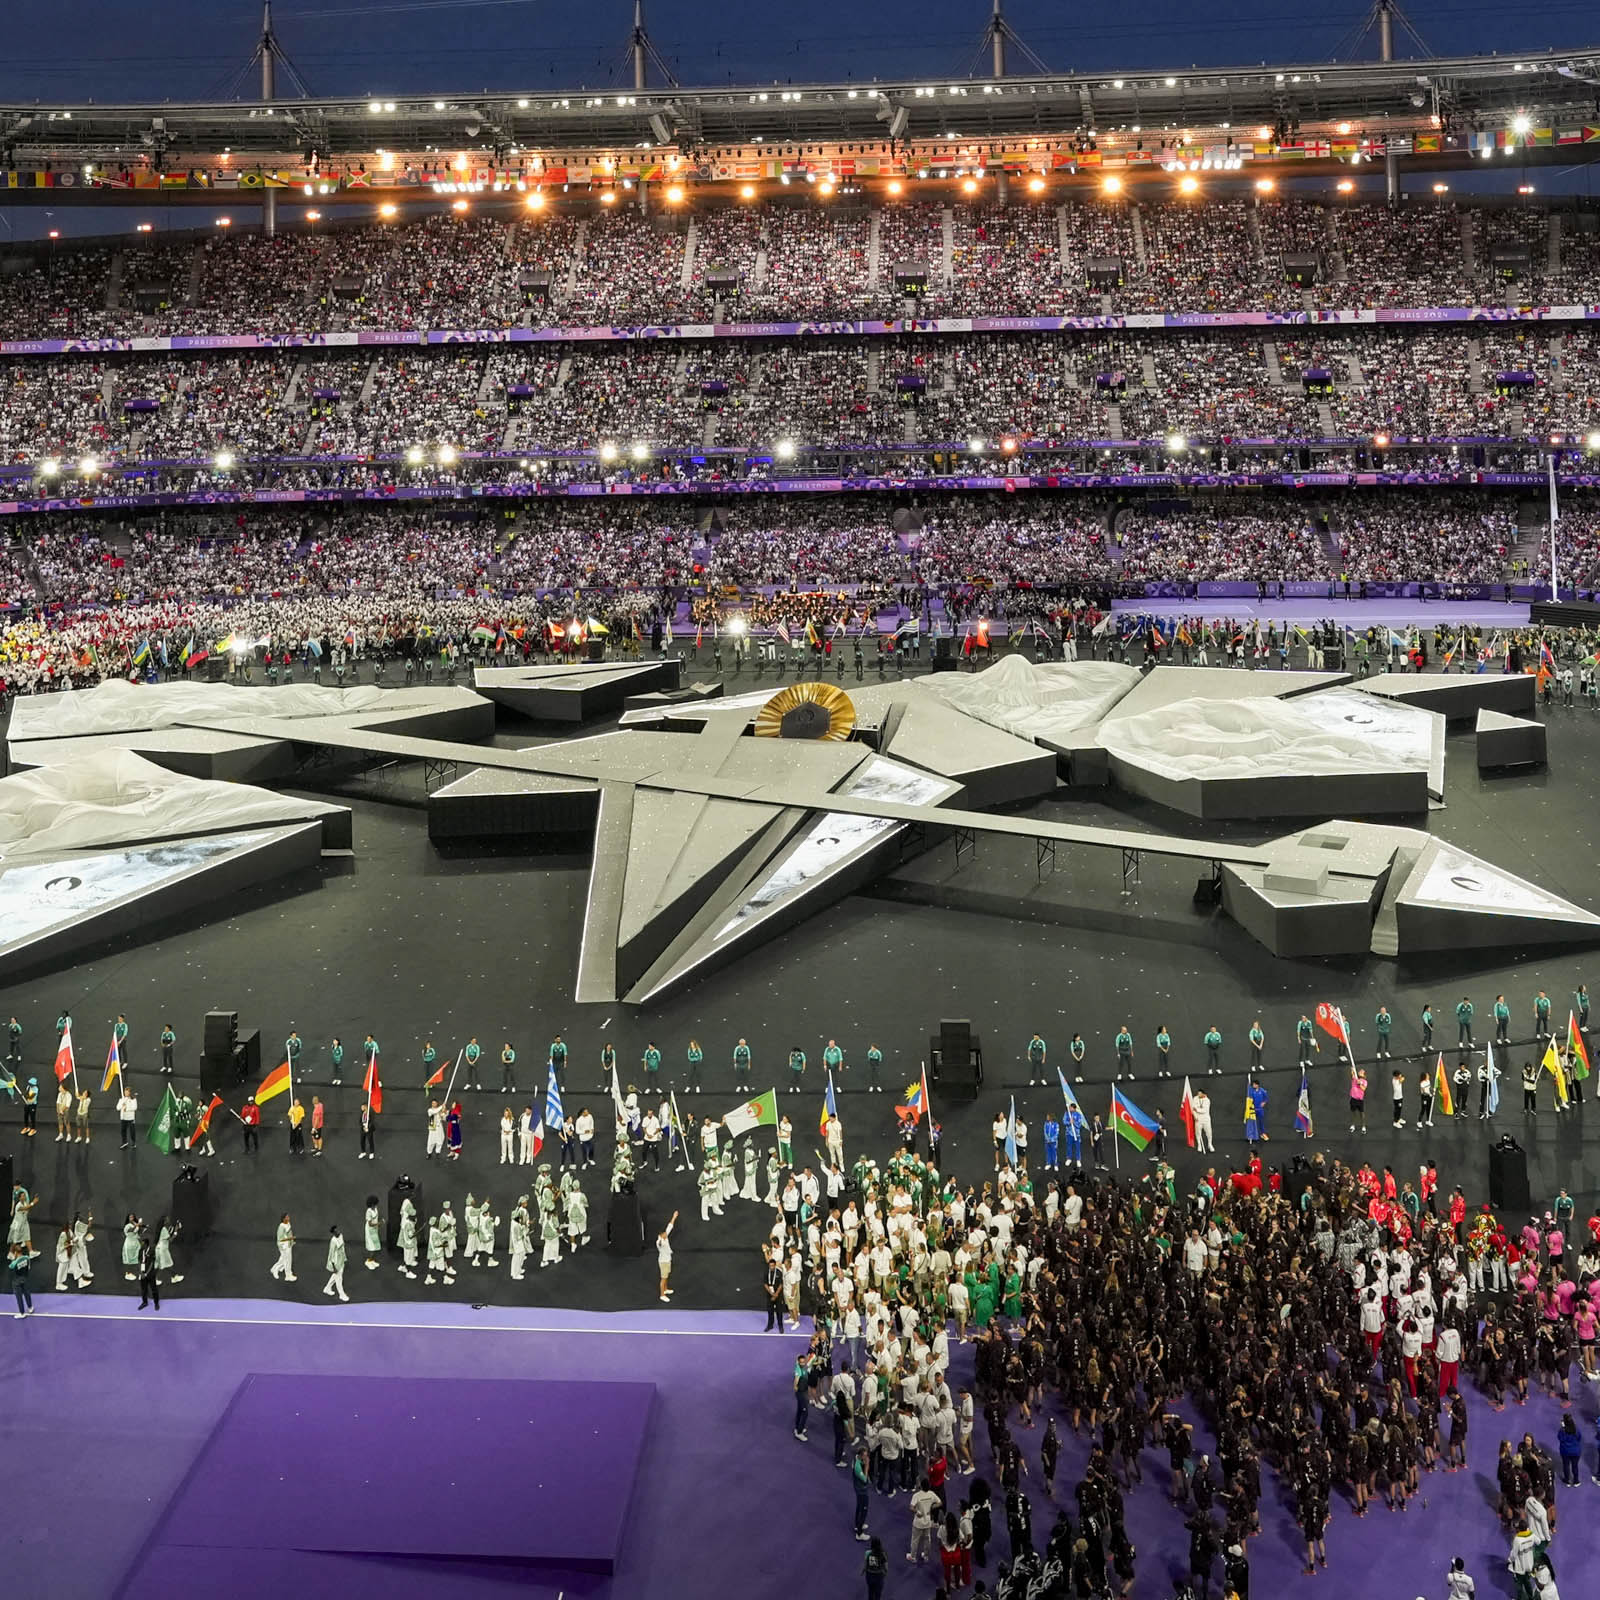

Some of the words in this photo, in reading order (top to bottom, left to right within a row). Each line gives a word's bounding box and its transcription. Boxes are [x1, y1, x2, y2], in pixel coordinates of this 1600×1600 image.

[1394, 311, 1421, 319] PARIS
[1424, 310, 1448, 318] 2024
[1182, 316, 1207, 324] PARIS
[731, 326, 756, 334] PARIS
[217, 337, 240, 345] 2024
